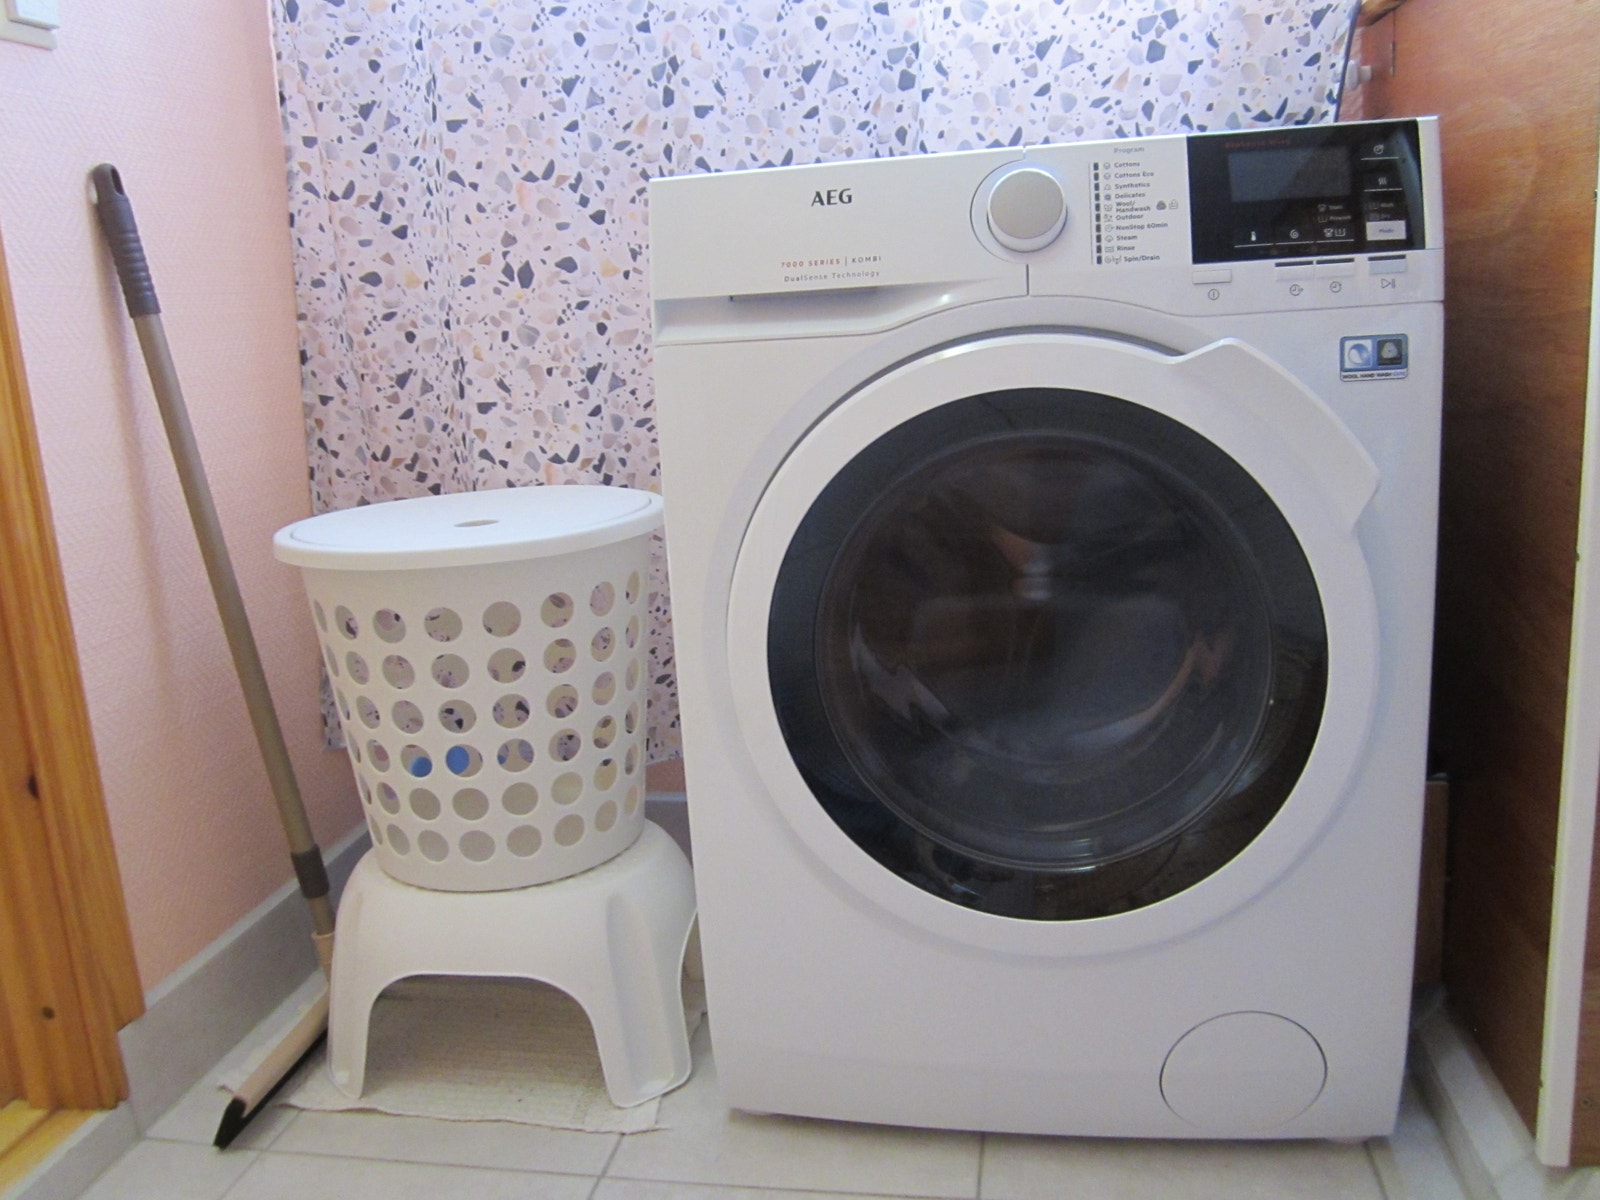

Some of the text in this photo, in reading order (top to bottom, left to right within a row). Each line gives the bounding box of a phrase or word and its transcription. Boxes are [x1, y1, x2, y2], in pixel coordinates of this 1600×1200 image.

[1114, 182, 1150, 190] Synthetics
[811, 188, 853, 207] AEG
[1116, 223, 1145, 231] NonStop
[781, 255, 882, 268] 7000 SERIES KOMBI
[1124, 254, 1160, 263] Spin/Drain
[784, 270, 880, 282] DualSense Technology
